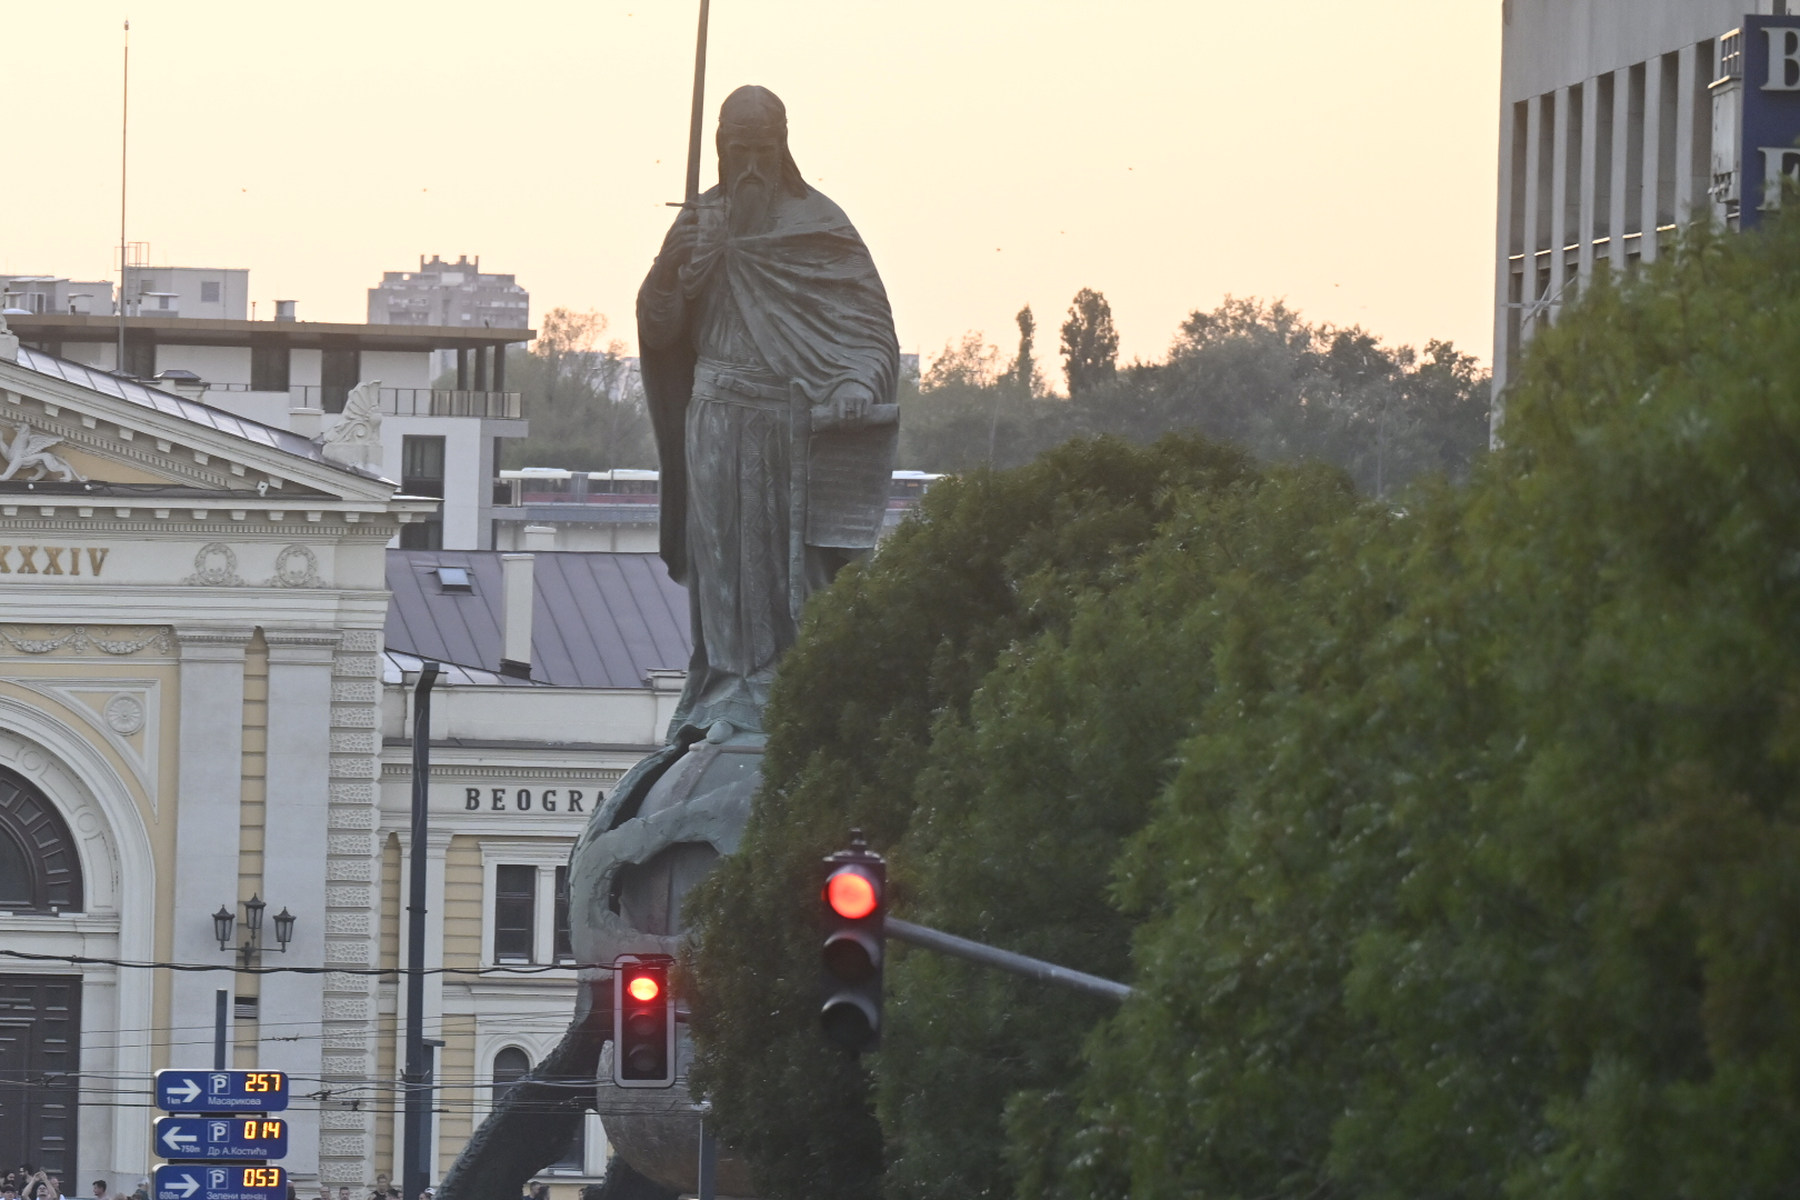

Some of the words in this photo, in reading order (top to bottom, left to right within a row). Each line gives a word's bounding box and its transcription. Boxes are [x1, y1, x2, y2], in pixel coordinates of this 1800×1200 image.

[245, 1073, 280, 1092] 257
[208, 1096, 262, 1107] Масарикова
[244, 1121, 280, 1139] 014
[181, 1145, 200, 1153] 750m
[207, 1146, 220, 1157] Др
[243, 1168, 279, 1187] 053
[206, 1192, 238, 1200] Зелени
